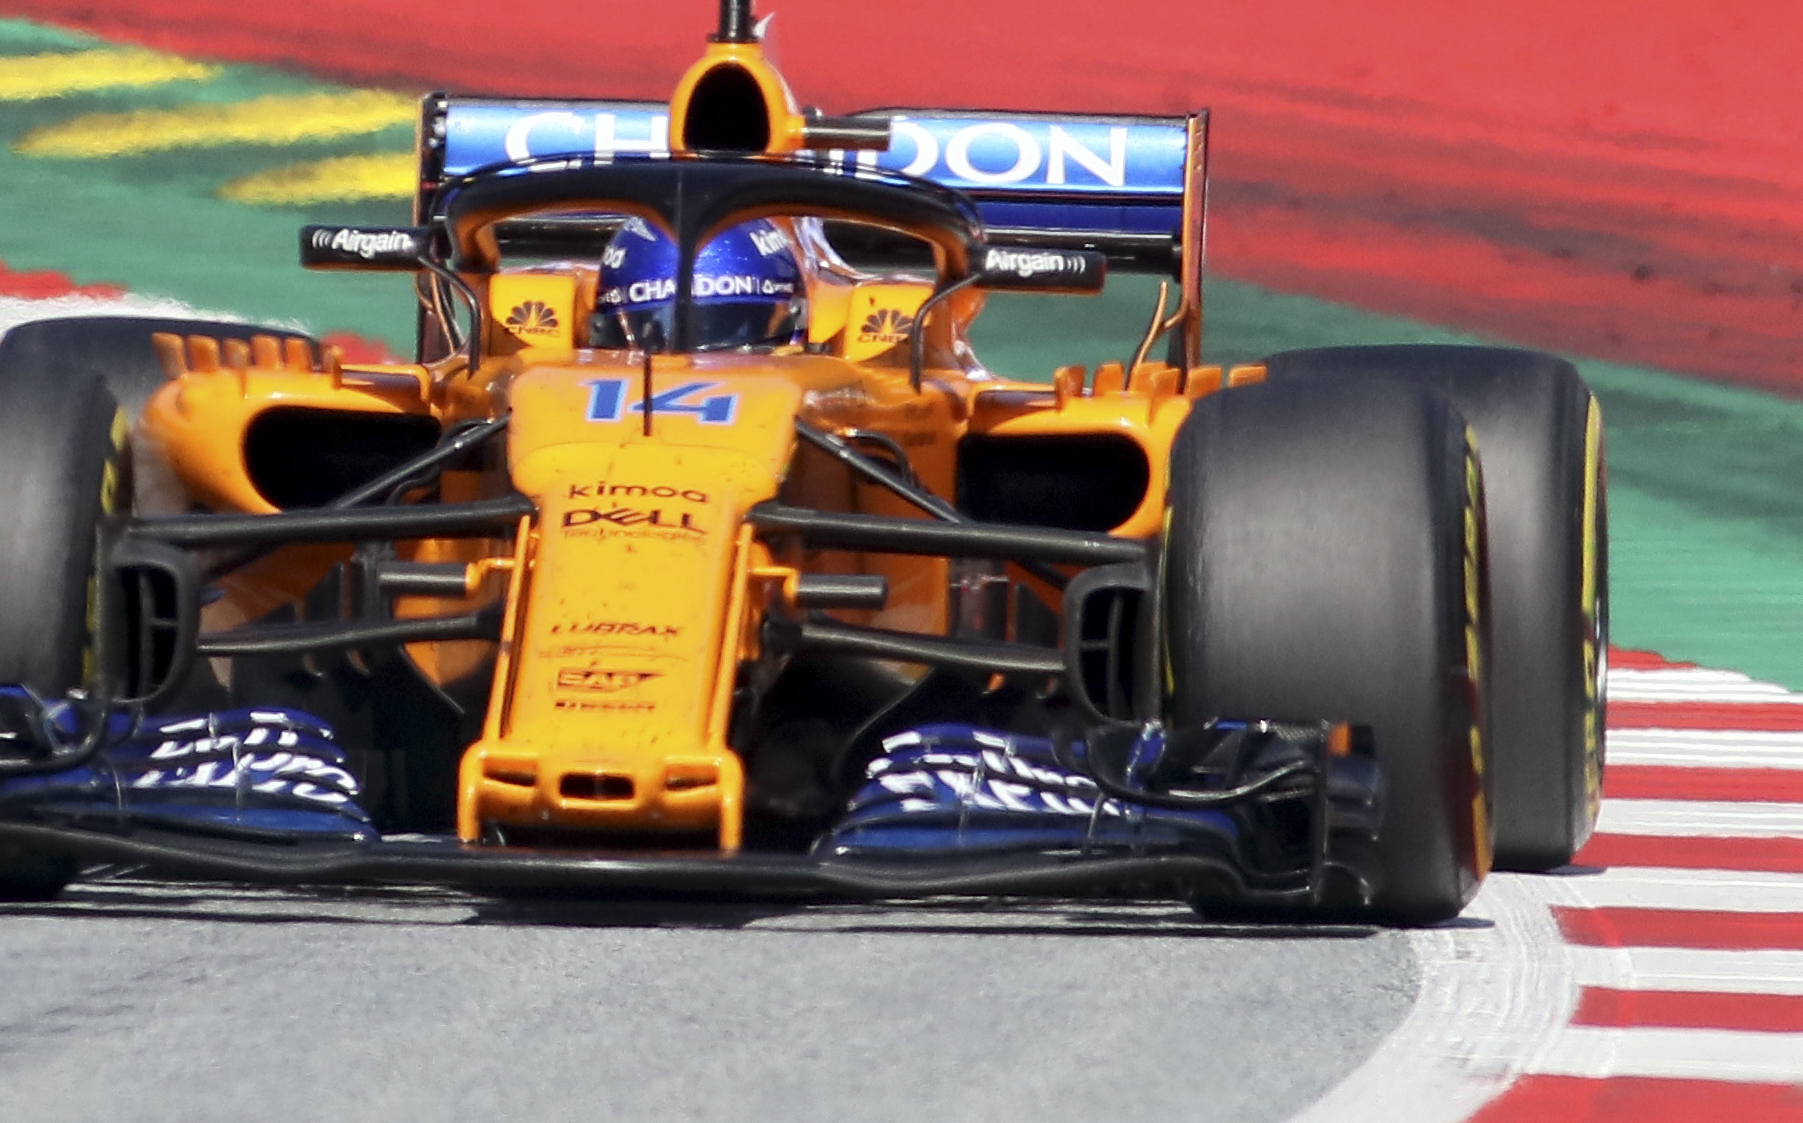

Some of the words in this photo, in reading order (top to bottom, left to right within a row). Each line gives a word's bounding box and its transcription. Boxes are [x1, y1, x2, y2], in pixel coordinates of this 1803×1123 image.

[504, 110, 1128, 186] CHDON
[331, 228, 414, 258] Airgain
[985, 248, 1064, 278] Airgain
[629, 276, 752, 303] CHADON
[581, 378, 740, 425] 14
[568, 480, 710, 503] kimoa
[561, 507, 709, 535] DELL
